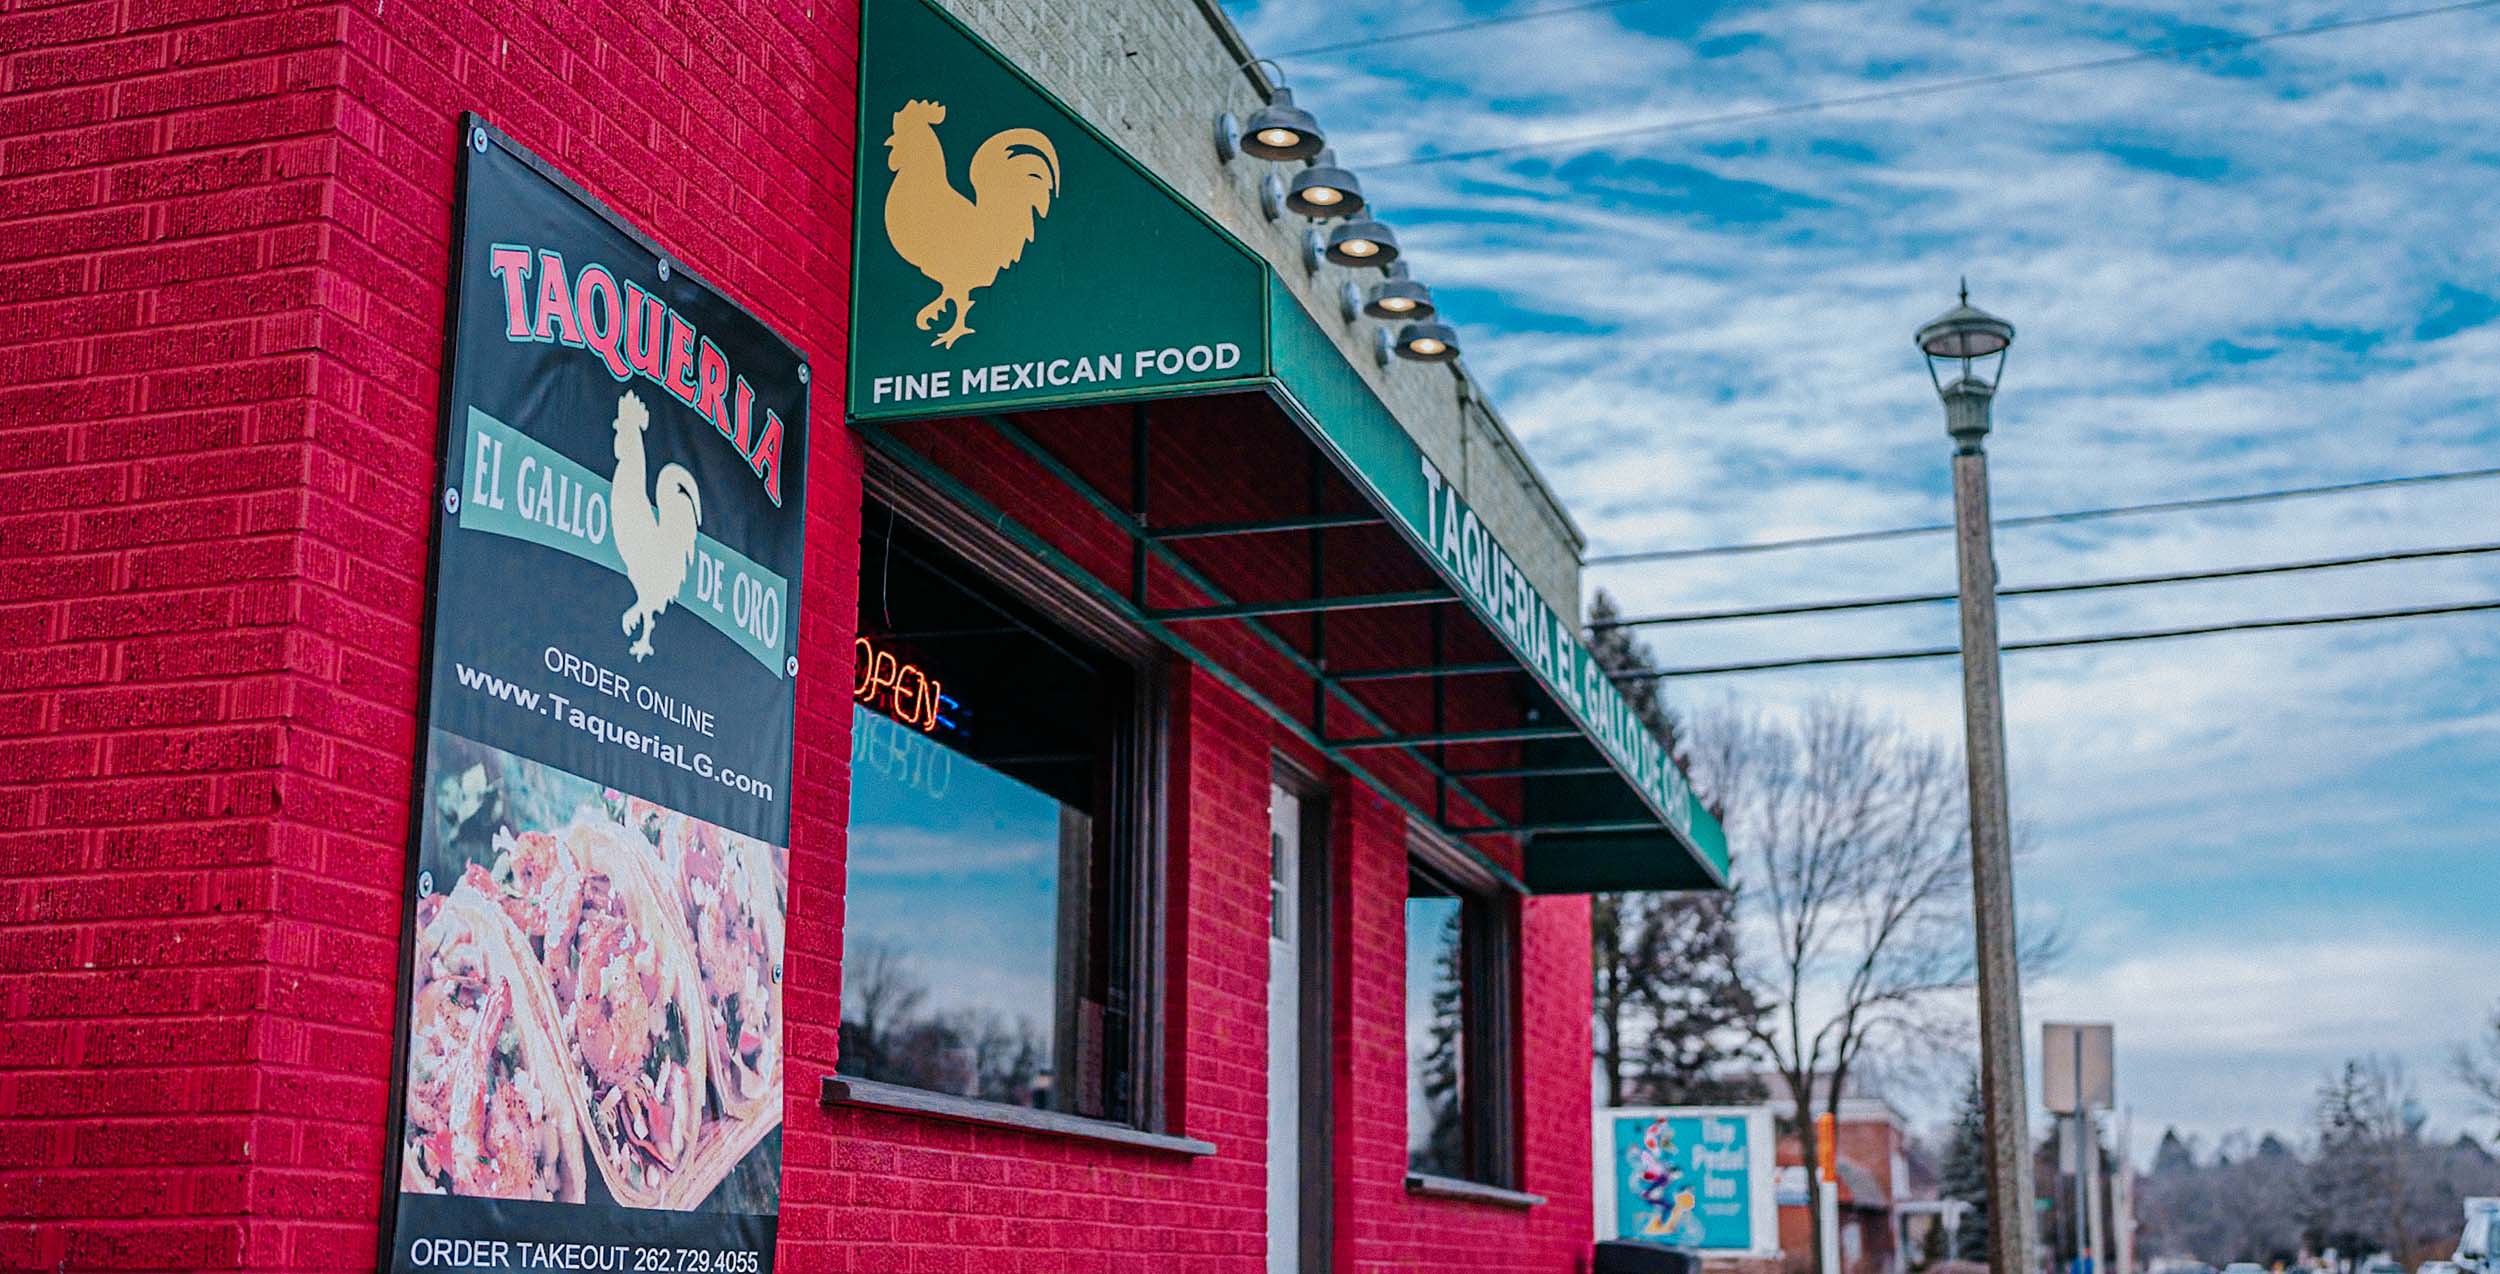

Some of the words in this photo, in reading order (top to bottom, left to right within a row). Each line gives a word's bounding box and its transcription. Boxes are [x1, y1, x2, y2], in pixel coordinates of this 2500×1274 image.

[490, 243, 784, 508] TAQUERIA
[872, 371, 950, 404] FINE
[961, 352, 1123, 395] MEXICAN
[1135, 342, 1241, 378] FOOD
[471, 430, 504, 512] EL
[515, 455, 607, 545] GALLO
[696, 549, 725, 614] DE
[732, 571, 780, 649] ORO
[1421, 455, 1554, 680] TAQUERIA
[1556, 617, 1583, 710] EL
[1584, 657, 1640, 778] GALLO
[456, 662, 774, 801] www.TaqueriaLG.com
[544, 646, 630, 703] ORDER
[636, 685, 715, 738] ONLINE
[853, 636, 941, 732] OPEN
[410, 1238, 510, 1268] ORDER
[516, 1242, 630, 1271] TAKEOUT
[633, 1247, 759, 1274] 262.729.4055
